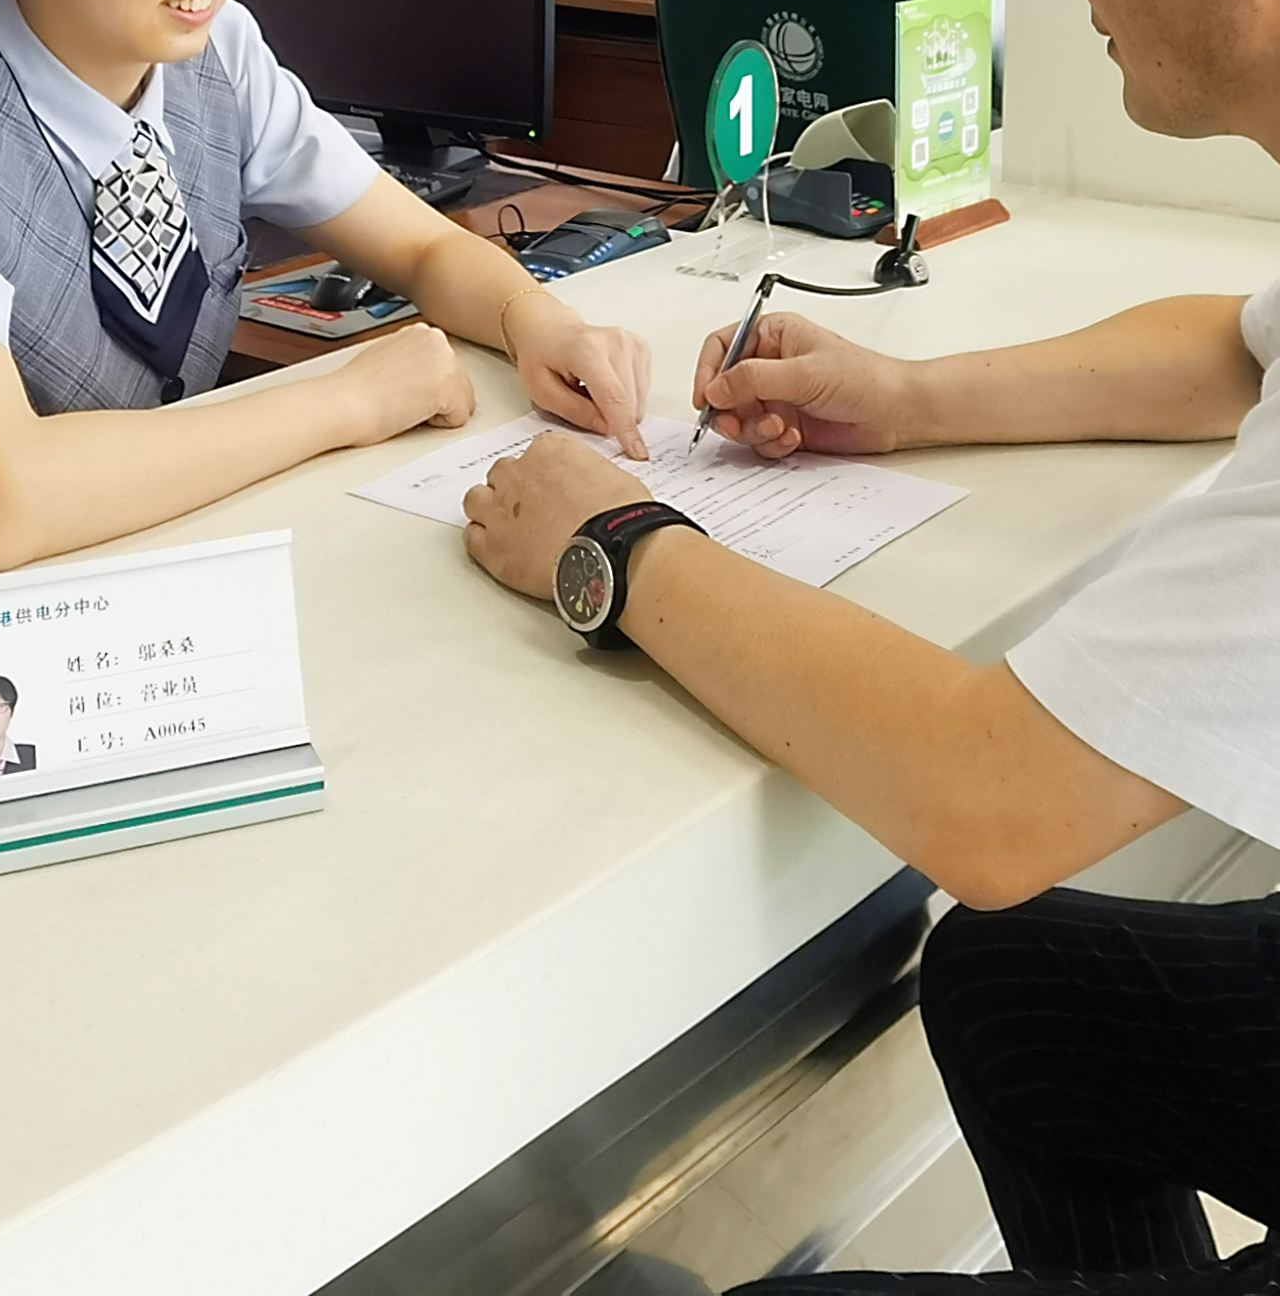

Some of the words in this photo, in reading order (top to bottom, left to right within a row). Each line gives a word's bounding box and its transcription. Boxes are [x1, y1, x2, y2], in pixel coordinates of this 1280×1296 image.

[729, 74, 754, 157] 1
[141, 676, 198, 702] 营业员
[143, 717, 207, 742] A00645
